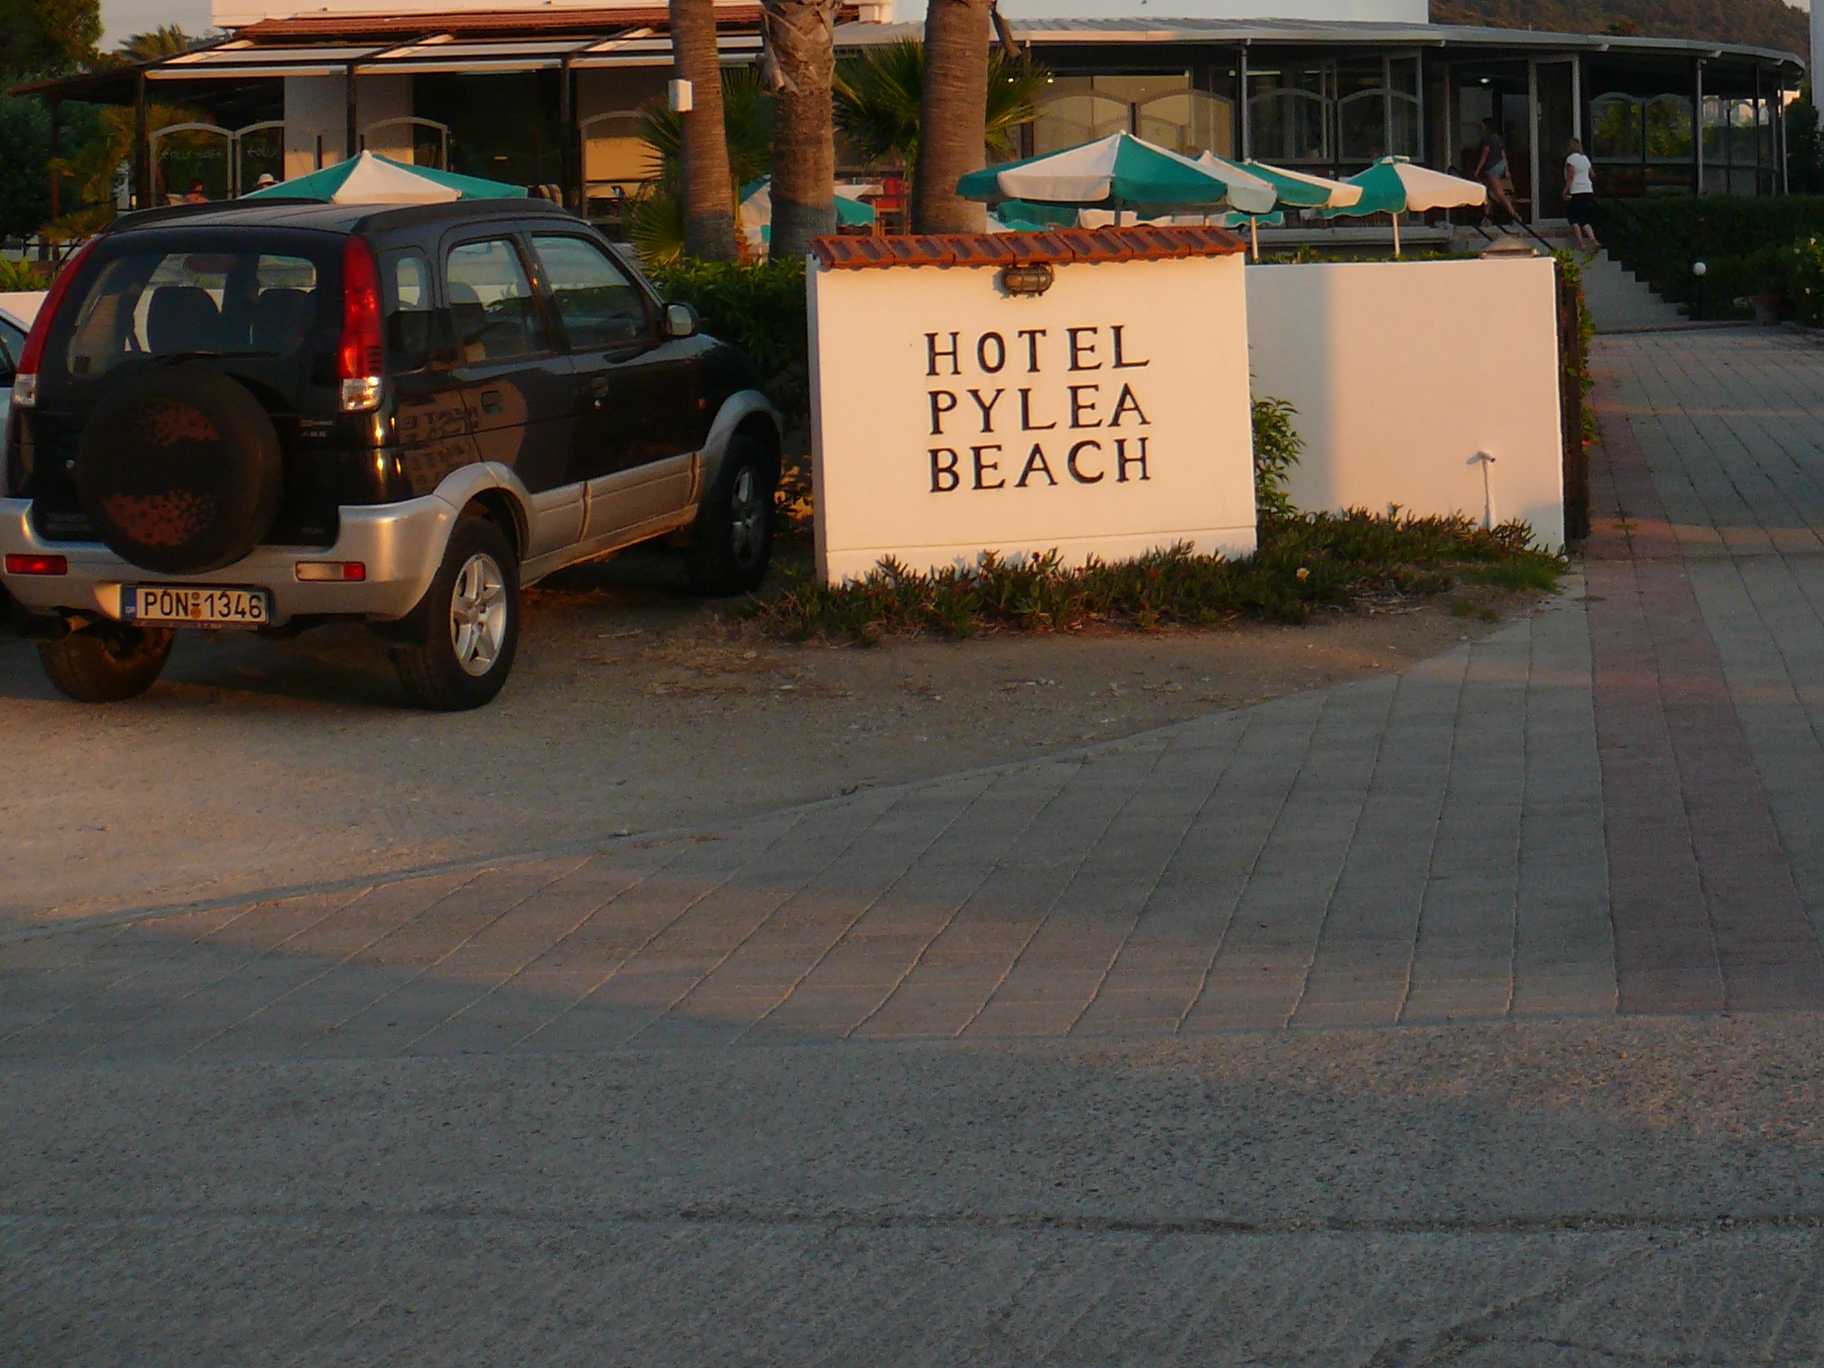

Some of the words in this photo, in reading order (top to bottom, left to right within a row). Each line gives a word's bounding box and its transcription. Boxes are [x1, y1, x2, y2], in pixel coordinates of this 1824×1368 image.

[923, 324, 1151, 377] HOTEL
[926, 382, 1152, 436] PYLEA
[926, 436, 1152, 494] BEACH
